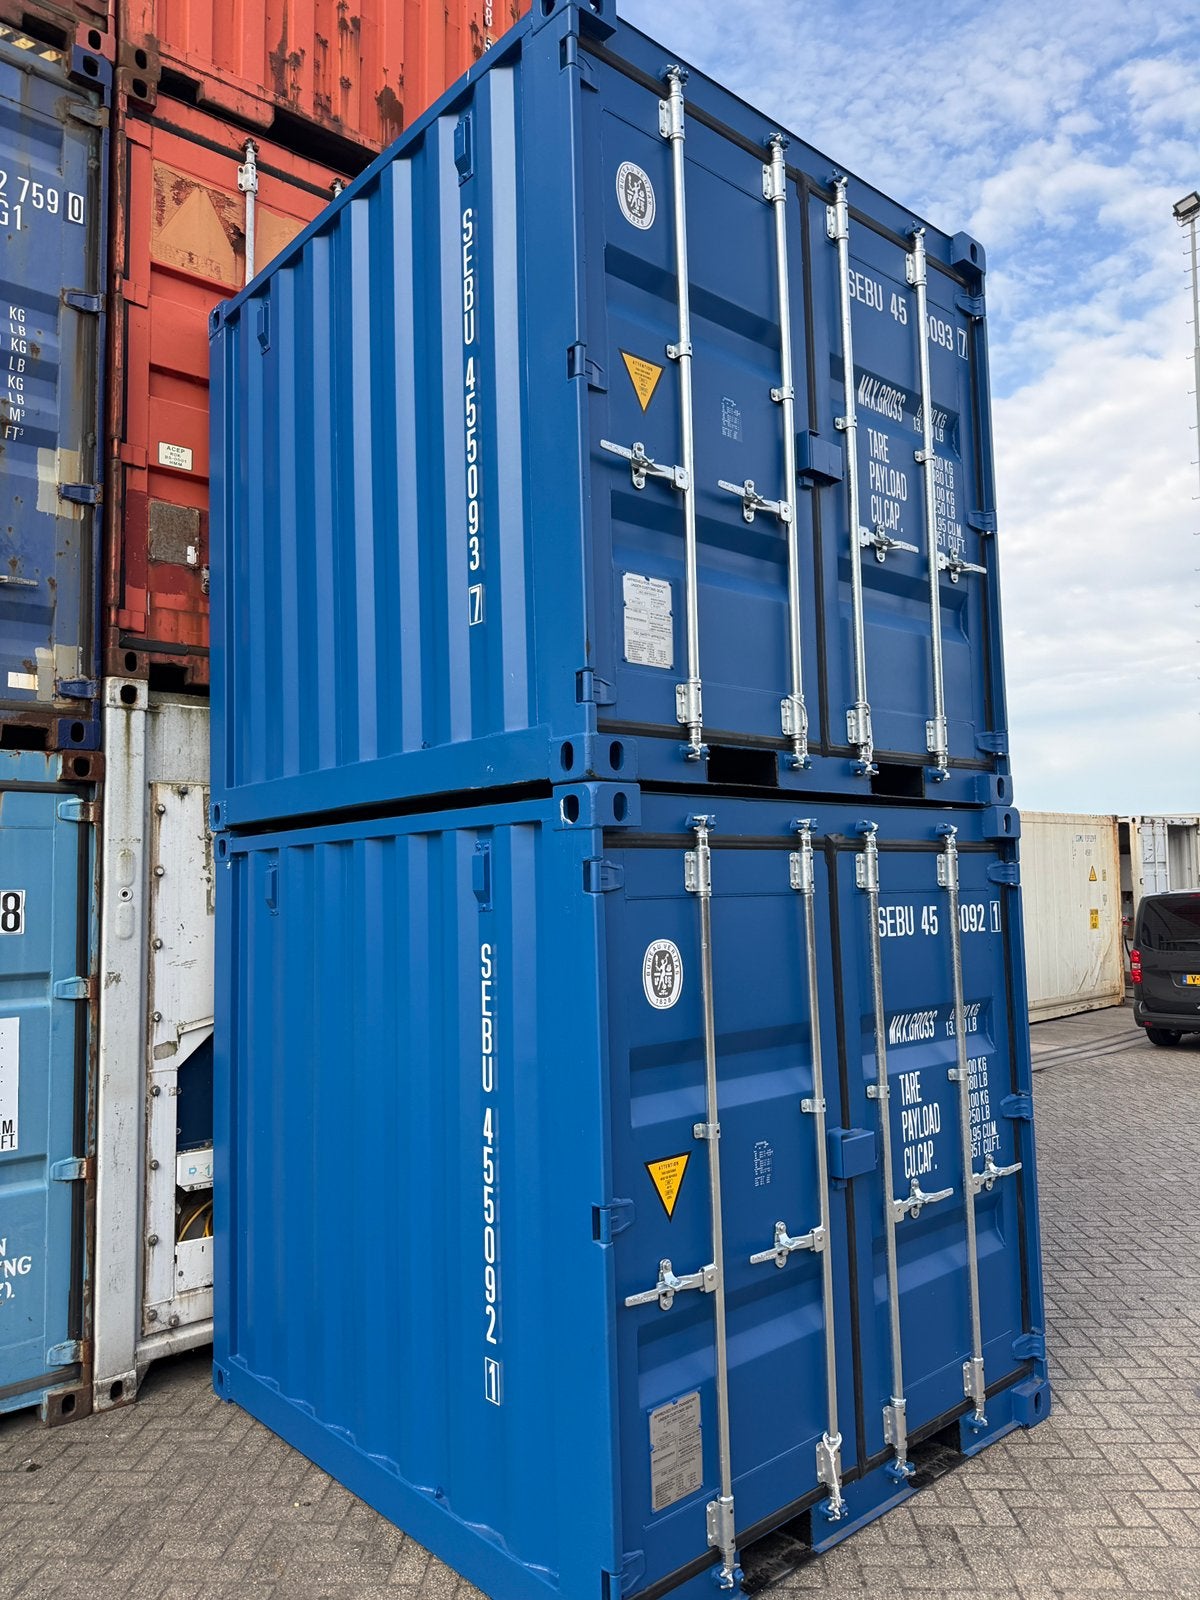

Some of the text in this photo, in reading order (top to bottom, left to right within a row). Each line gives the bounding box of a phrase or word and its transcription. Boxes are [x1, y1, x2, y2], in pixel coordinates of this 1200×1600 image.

[17, 176, 59, 214] 759
[71, 195, 82, 222] 0
[9, 305, 25, 323] KG
[848, 268, 883, 312] SEBU
[958, 328, 968, 360] 7
[10, 323, 26, 336] LB
[11, 337, 26, 354] KG
[9, 356, 25, 373] LB
[8, 375, 24, 390] KG
[9, 392, 24, 405] LB
[858, 374, 906, 423] MAX.GROSS
[936, 411, 947, 428] KG
[462, 207, 481, 623] SEBU 455093 7
[935, 426, 944, 442] LB
[166, 445, 185, 453] ACEP
[868, 428, 889, 463] TARE
[944, 459, 953, 475] KG
[869, 461, 907, 502] PAYLOAD
[945, 474, 954, 489] LB
[946, 490, 955, 505] KG
[946, 504, 956, 519] LB
[1, 892, 21, 932] 8
[878, 905, 914, 938] SEBU
[959, 903, 986, 933] 092
[991, 902, 1000, 931] 1
[646, 943, 662, 977] BUREAU
[889, 1009, 938, 1045] MAX.GROSS
[968, 1003, 980, 1017] KG
[968, 1016, 978, 1033] LB
[977, 1056, 988, 1072] KG
[978, 1071, 988, 1088] LB
[899, 1071, 922, 1106] TARE
[980, 1089, 990, 1105] KG
[981, 1105, 991, 1121] LB
[901, 1102, 941, 1143] PAYLOAD
[481, 943, 499, 1403] SEBU 455092 1
[0, 1255, 32, 1279] NG
